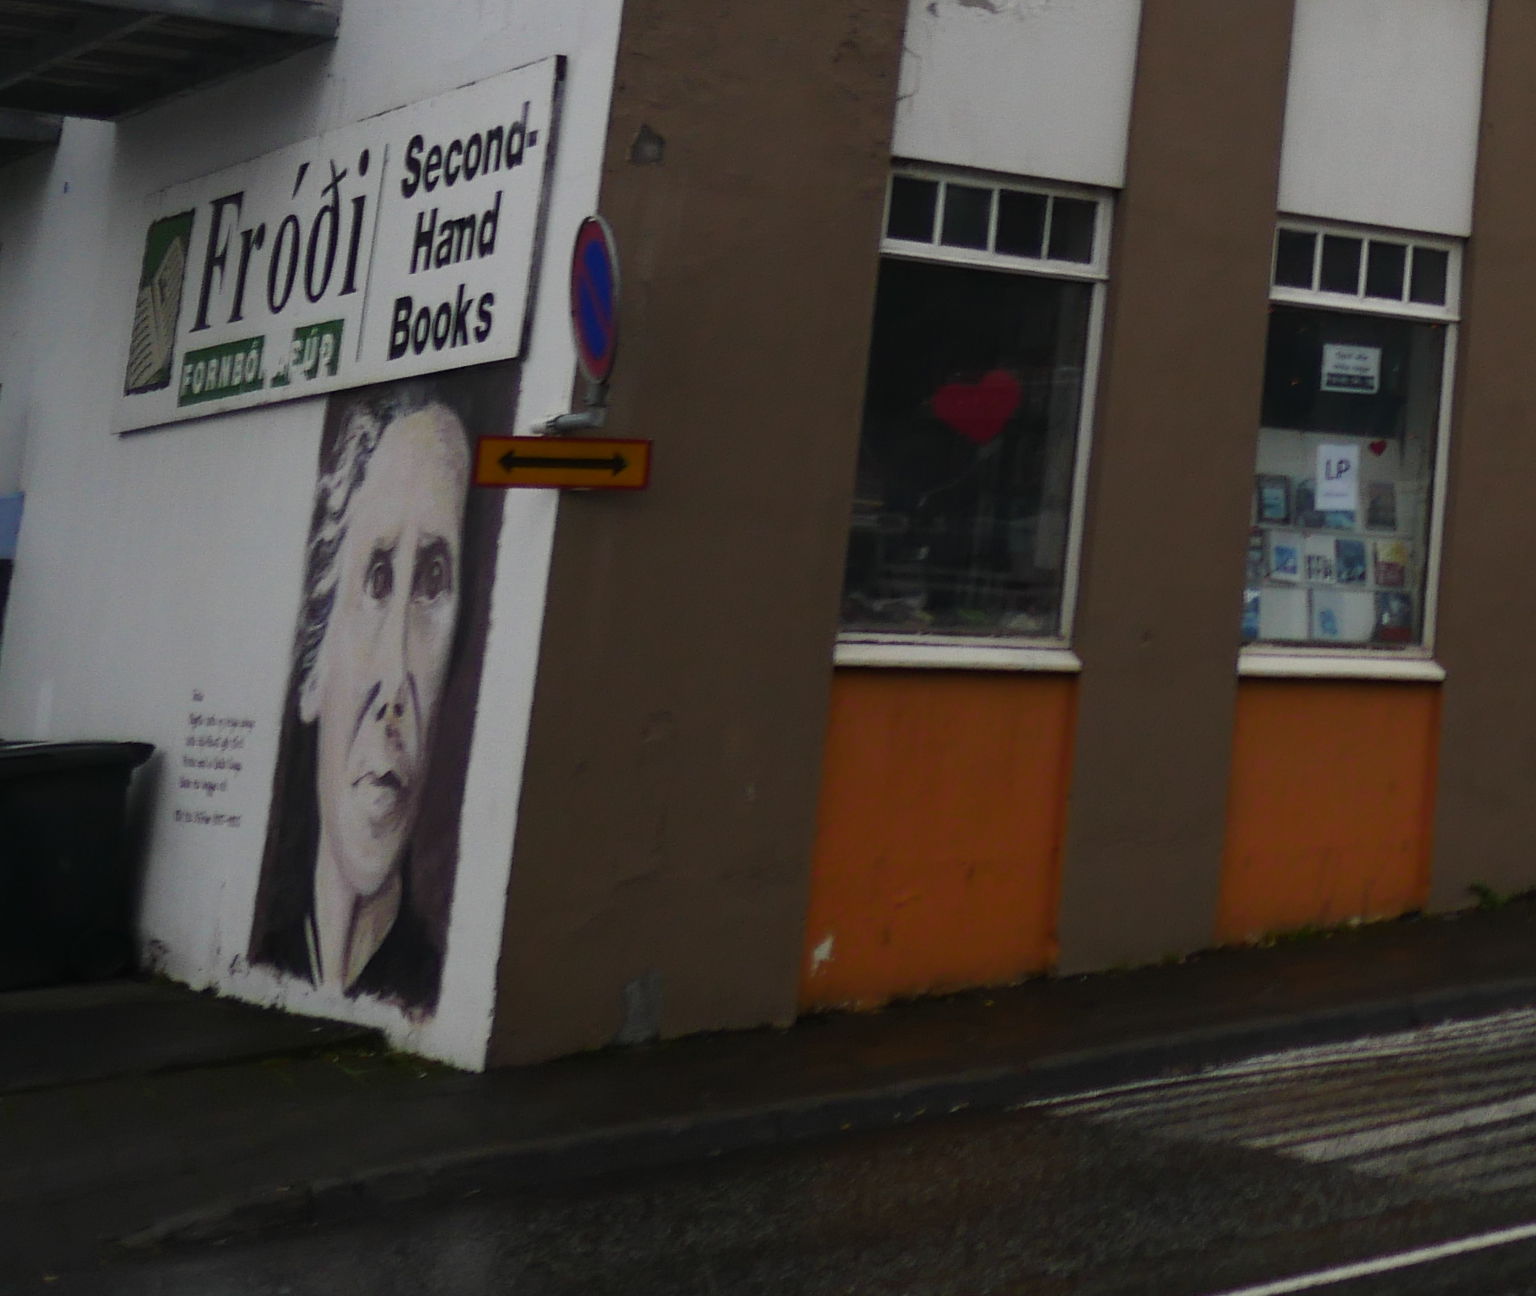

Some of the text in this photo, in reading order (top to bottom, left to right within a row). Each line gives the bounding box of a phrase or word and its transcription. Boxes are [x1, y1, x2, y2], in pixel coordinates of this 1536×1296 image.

[189, 149, 371, 332] Fróði
[409, 191, 503, 275] Hand
[387, 283, 494, 361] Books
